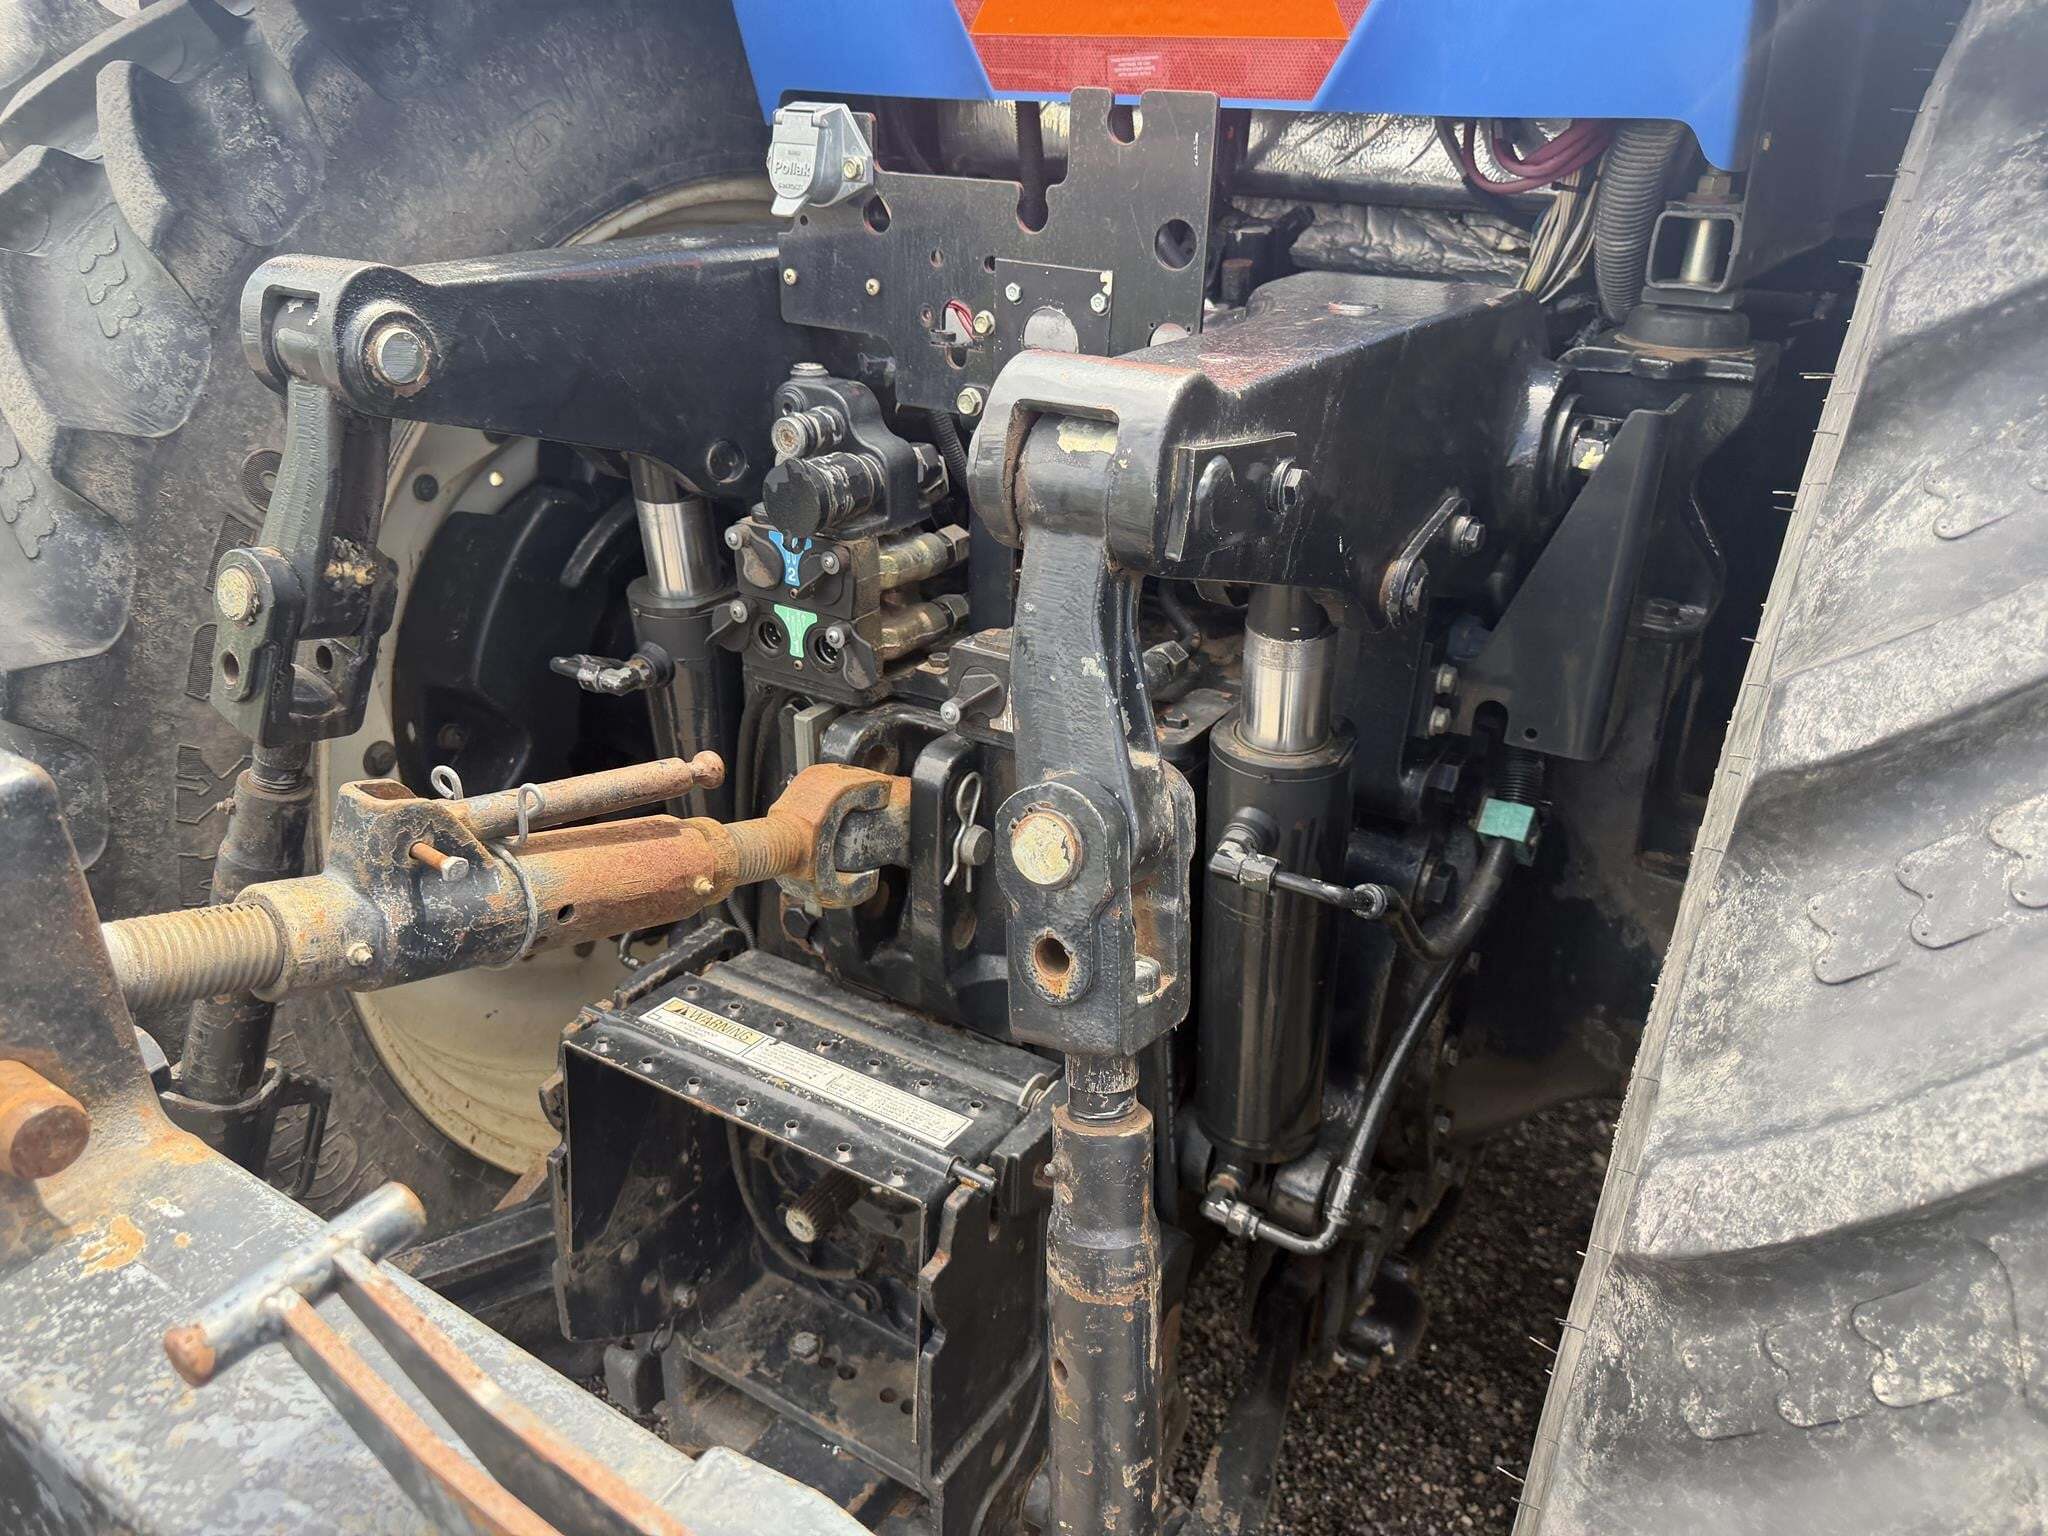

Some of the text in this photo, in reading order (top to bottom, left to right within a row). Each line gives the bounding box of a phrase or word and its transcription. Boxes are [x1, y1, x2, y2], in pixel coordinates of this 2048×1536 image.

[774, 162, 812, 178] Pollak
[787, 567, 796, 582] 2
[689, 1007, 754, 1041] WARNING
